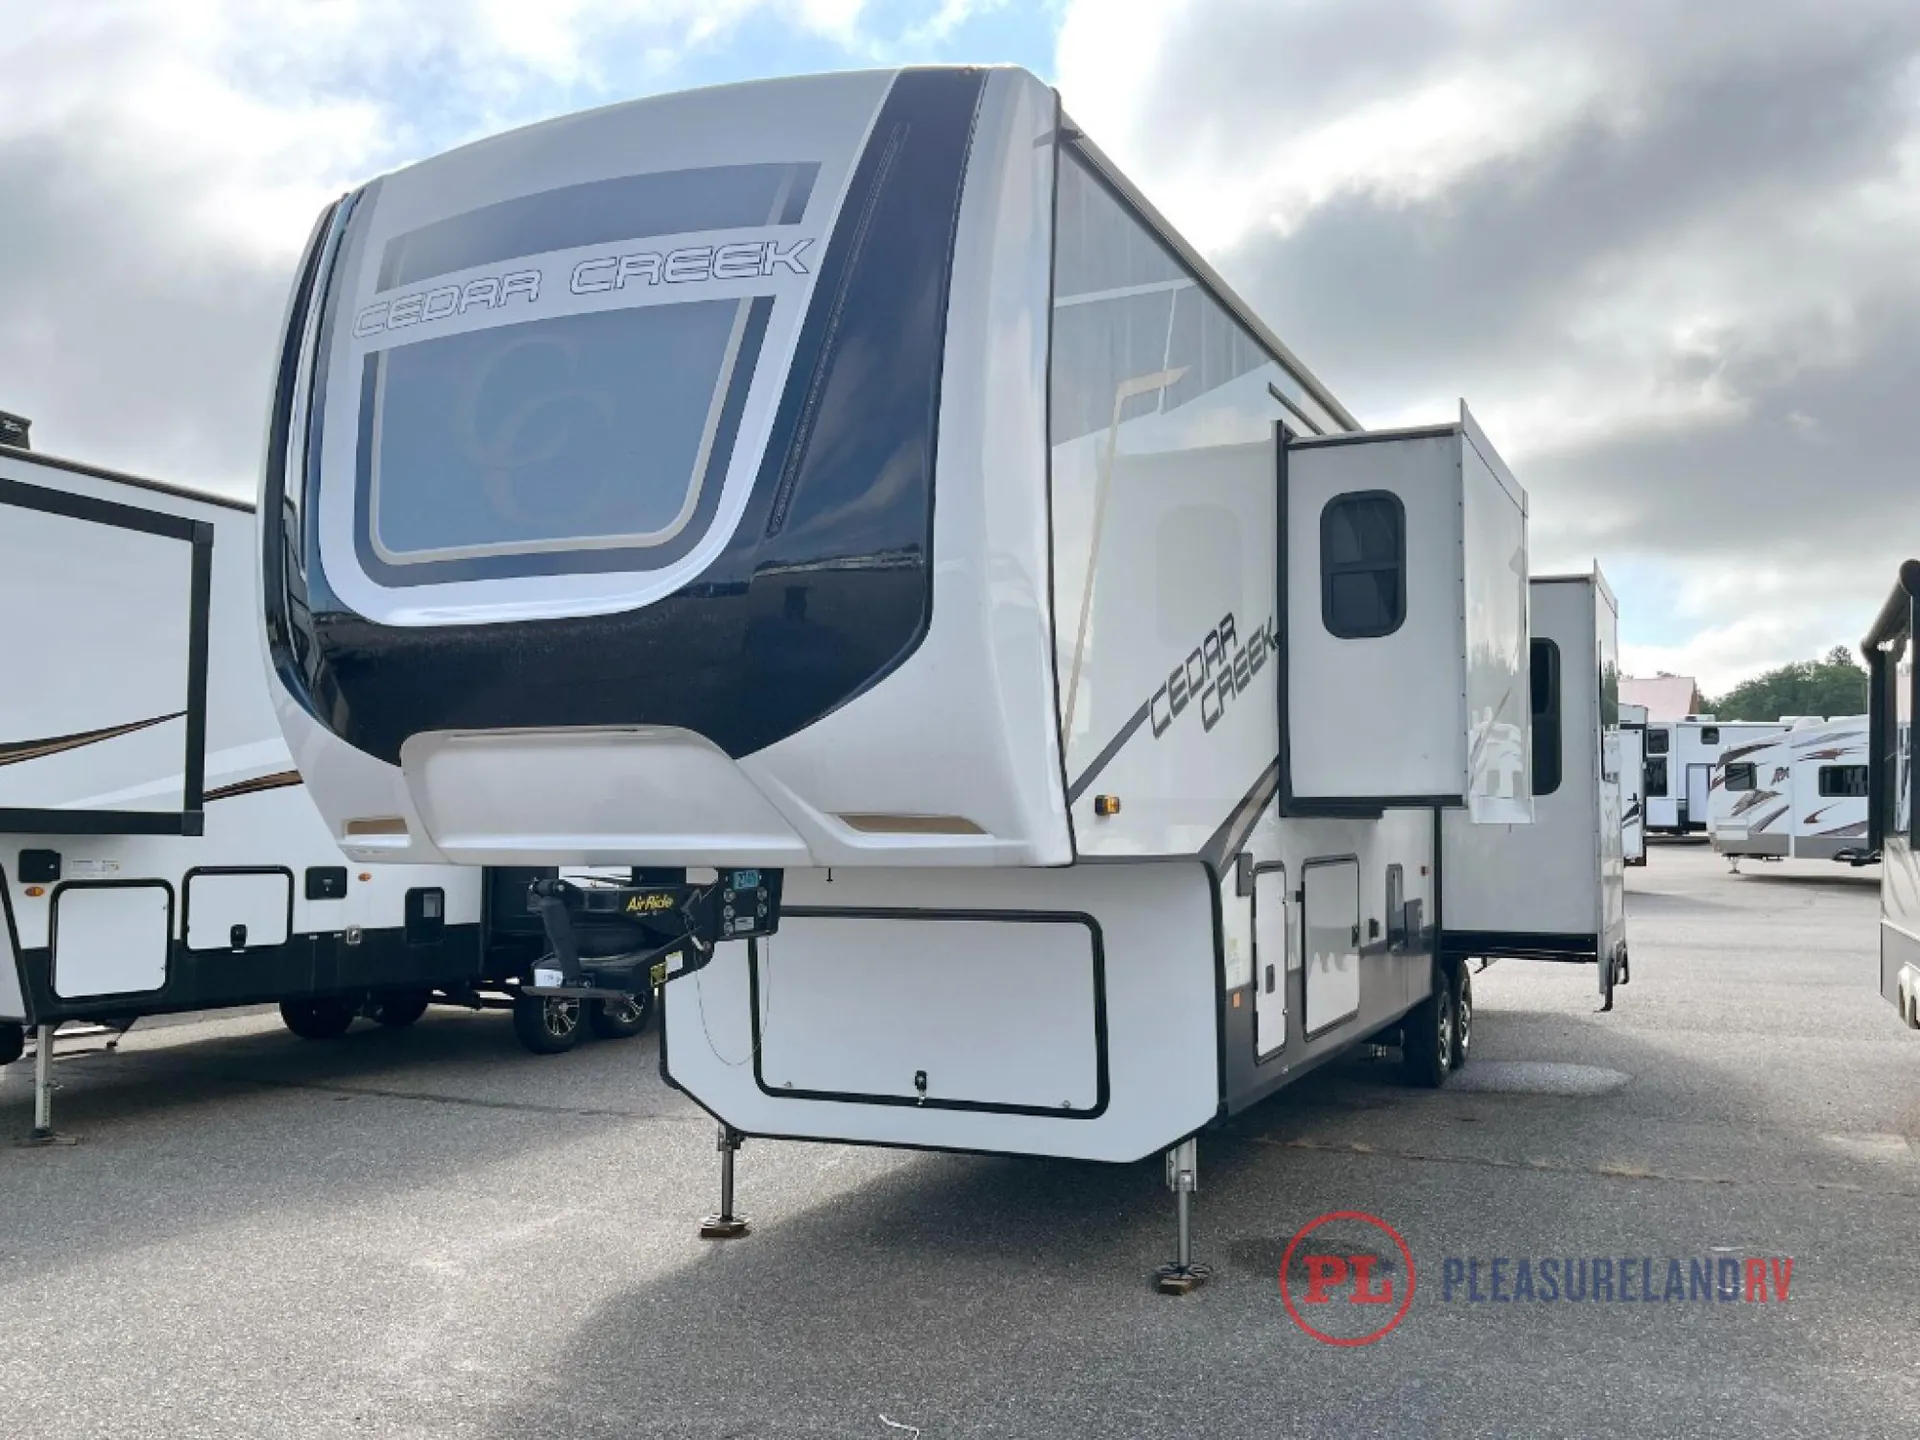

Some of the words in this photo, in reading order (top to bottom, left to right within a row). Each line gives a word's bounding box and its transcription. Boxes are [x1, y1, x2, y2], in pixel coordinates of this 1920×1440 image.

[353, 269, 543, 339] CEDAR
[570, 238, 816, 295] CREEK
[1150, 612, 1238, 740] CEDAR
[1201, 615, 1278, 734] CREEK
